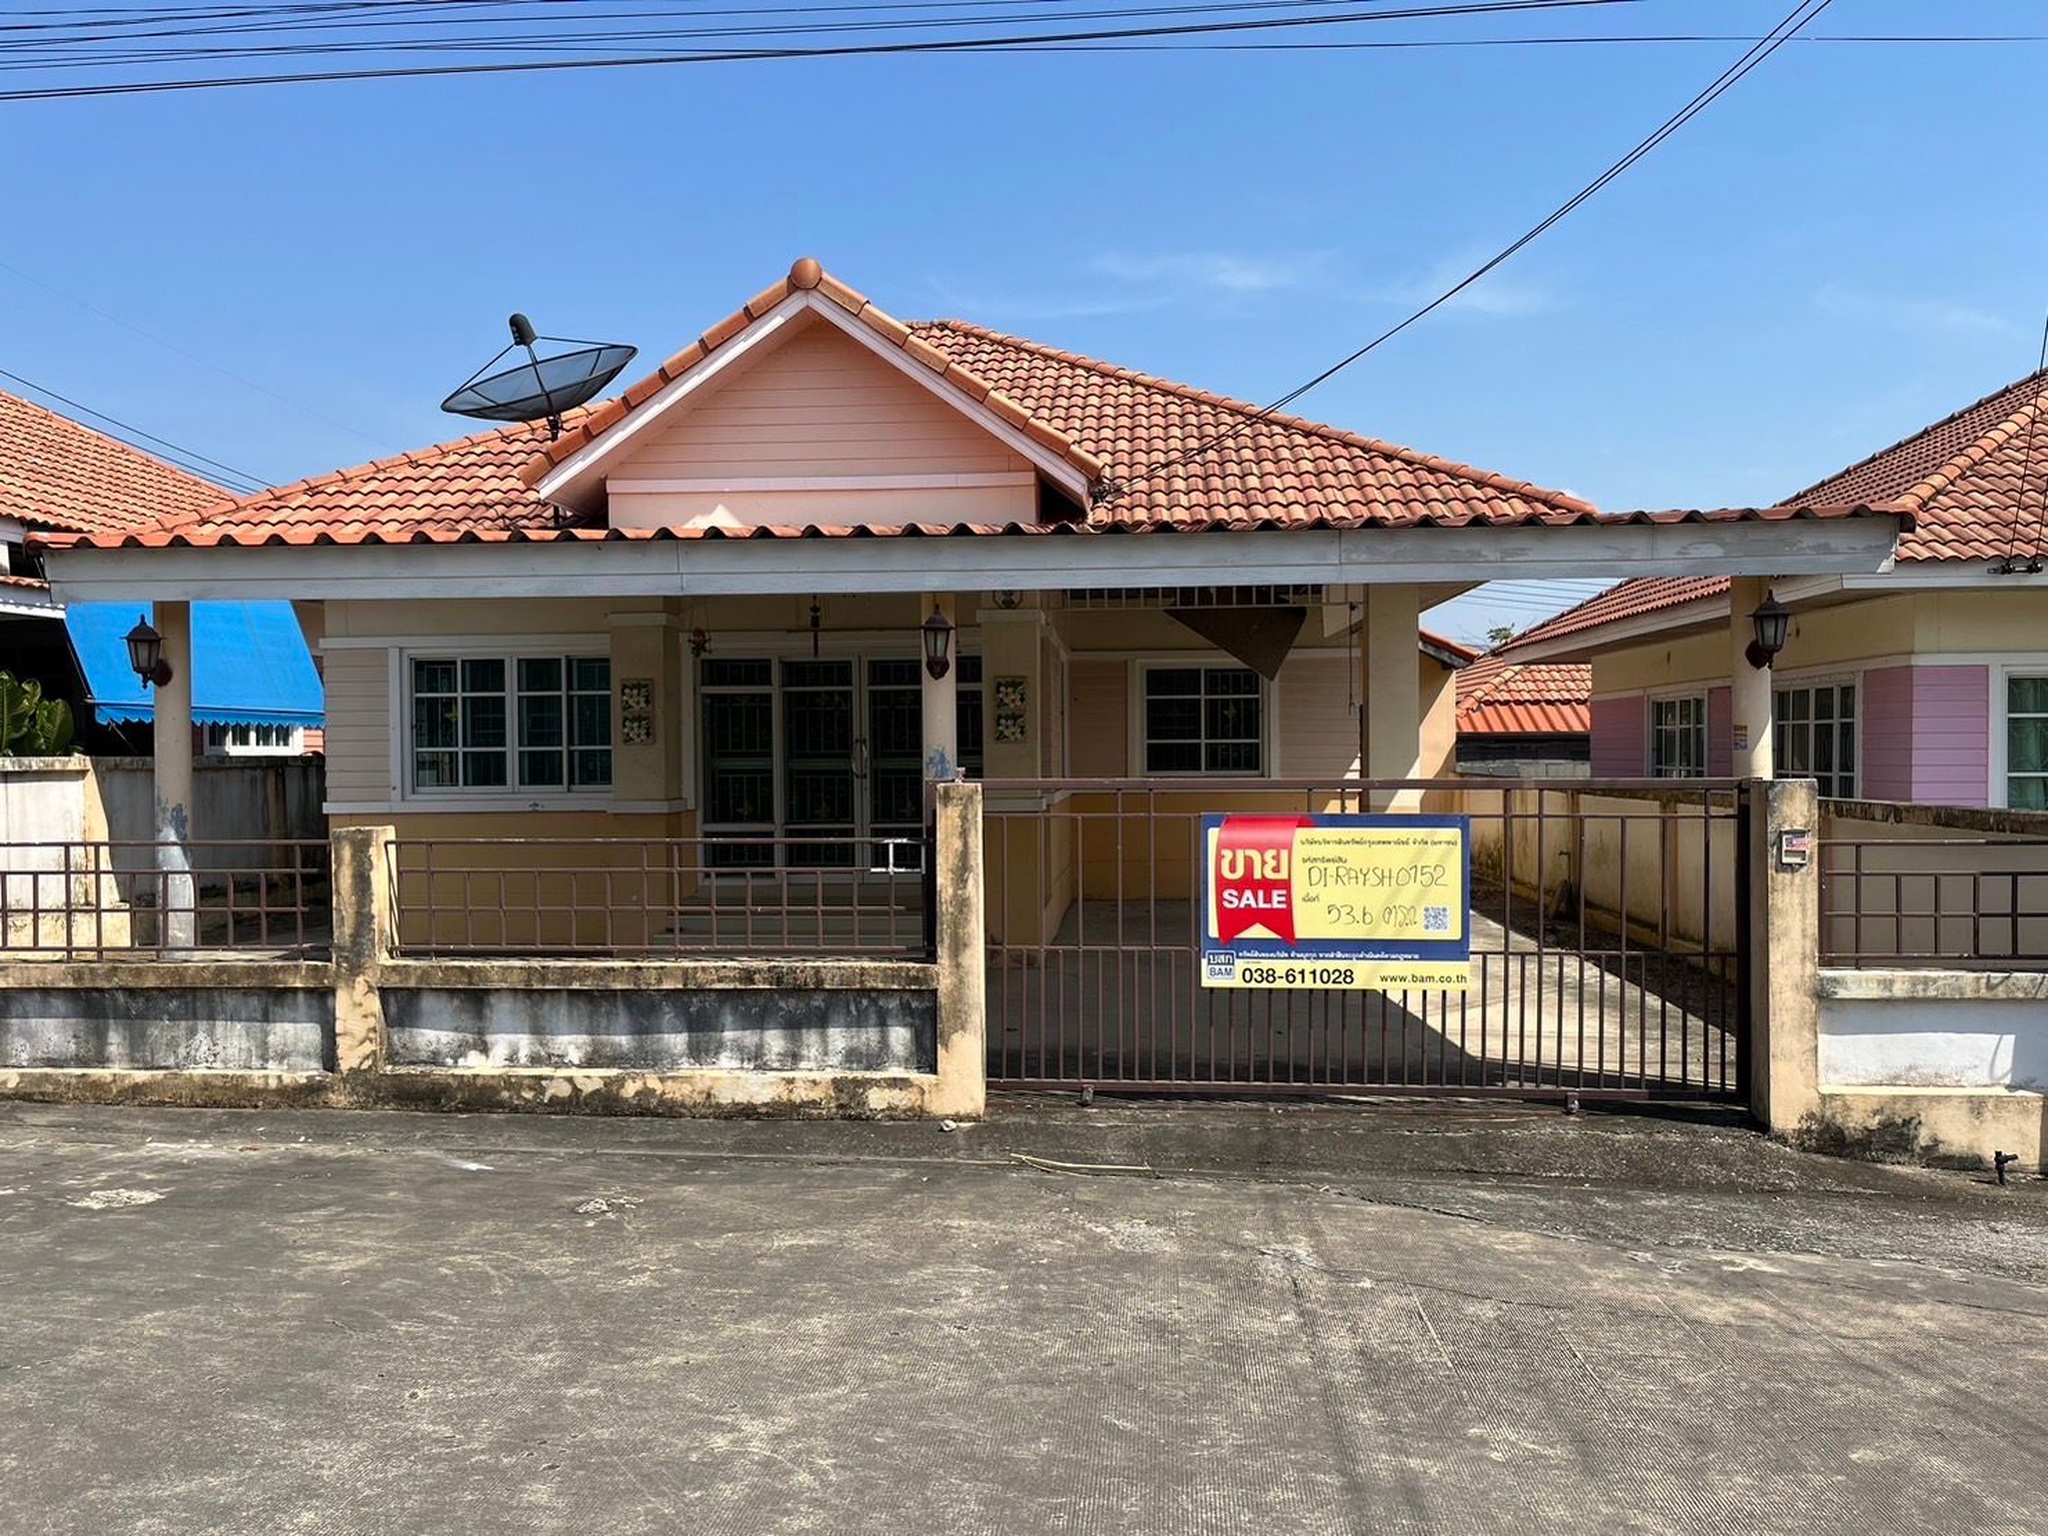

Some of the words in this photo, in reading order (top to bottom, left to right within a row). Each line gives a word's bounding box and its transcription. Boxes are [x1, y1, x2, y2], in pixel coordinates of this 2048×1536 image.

[1220, 849, 1289, 880] ขาย
[1221, 889, 1288, 909] SALE
[1327, 903, 1374, 926] 53.6
[1209, 967, 1233, 977] BAM
[1242, 968, 1355, 984] 038-611028
[1379, 973, 1468, 984] www.bam.co.th
